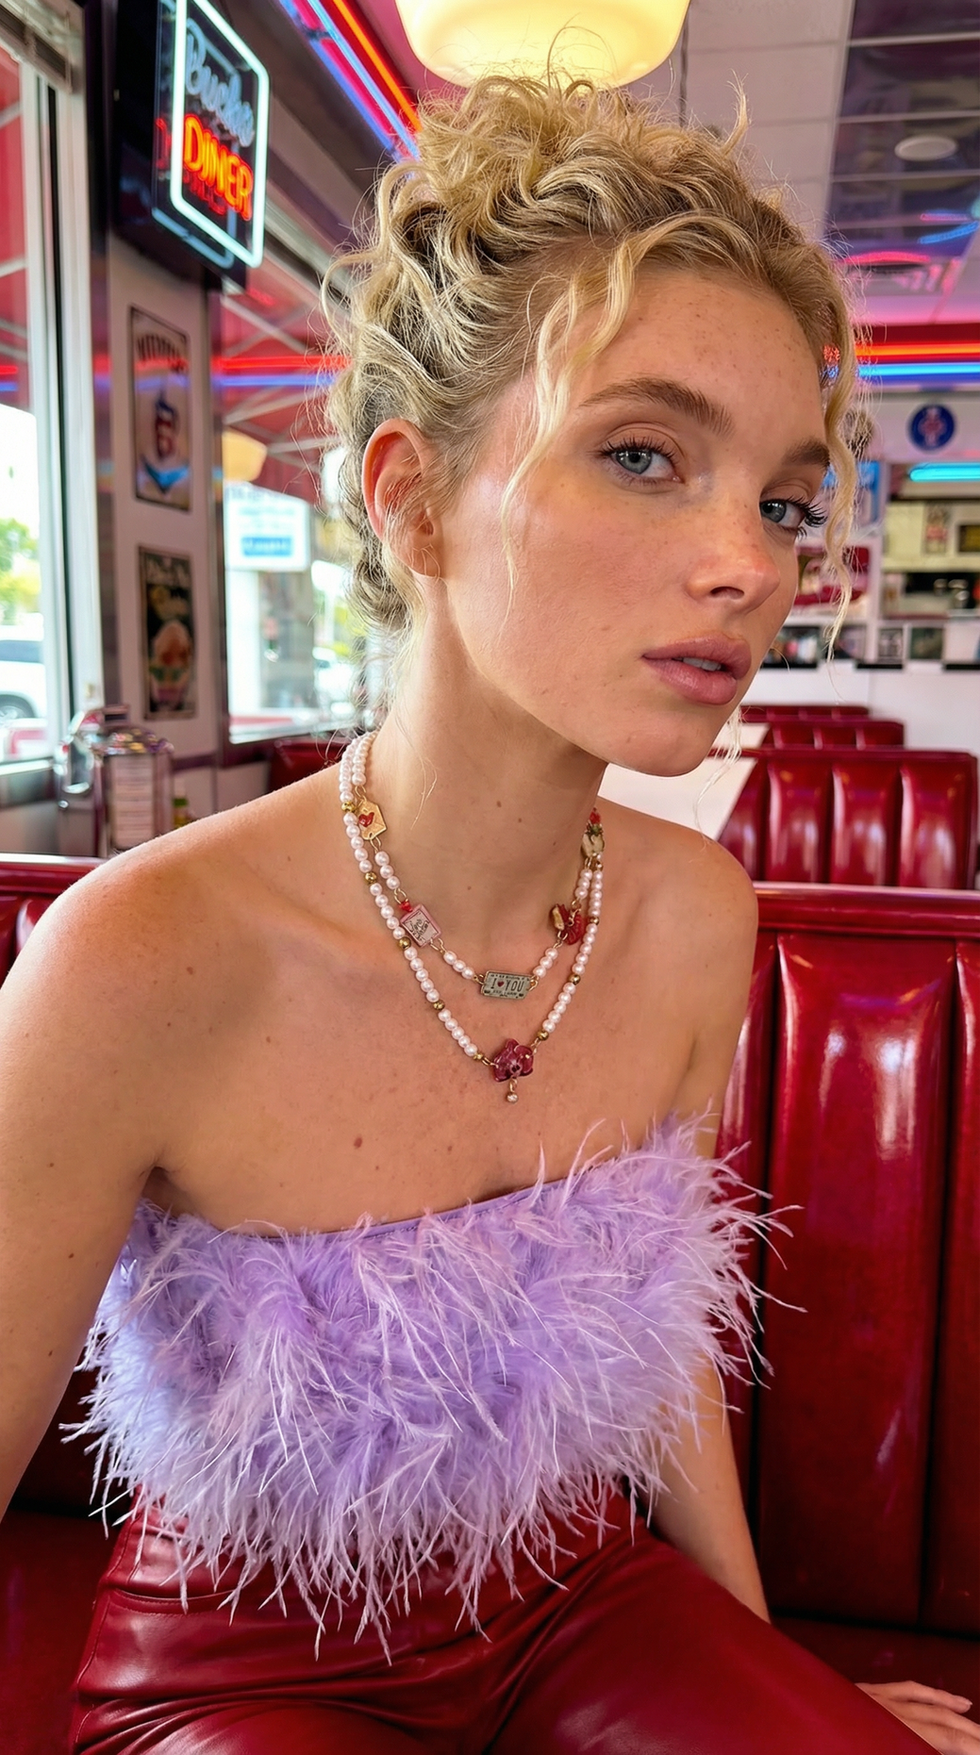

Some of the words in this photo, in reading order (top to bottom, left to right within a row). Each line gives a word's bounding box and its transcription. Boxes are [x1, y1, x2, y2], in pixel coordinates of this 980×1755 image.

[183, 114, 253, 221] DINER
[490, 978, 497, 989] I
[505, 979, 525, 992] YOU
